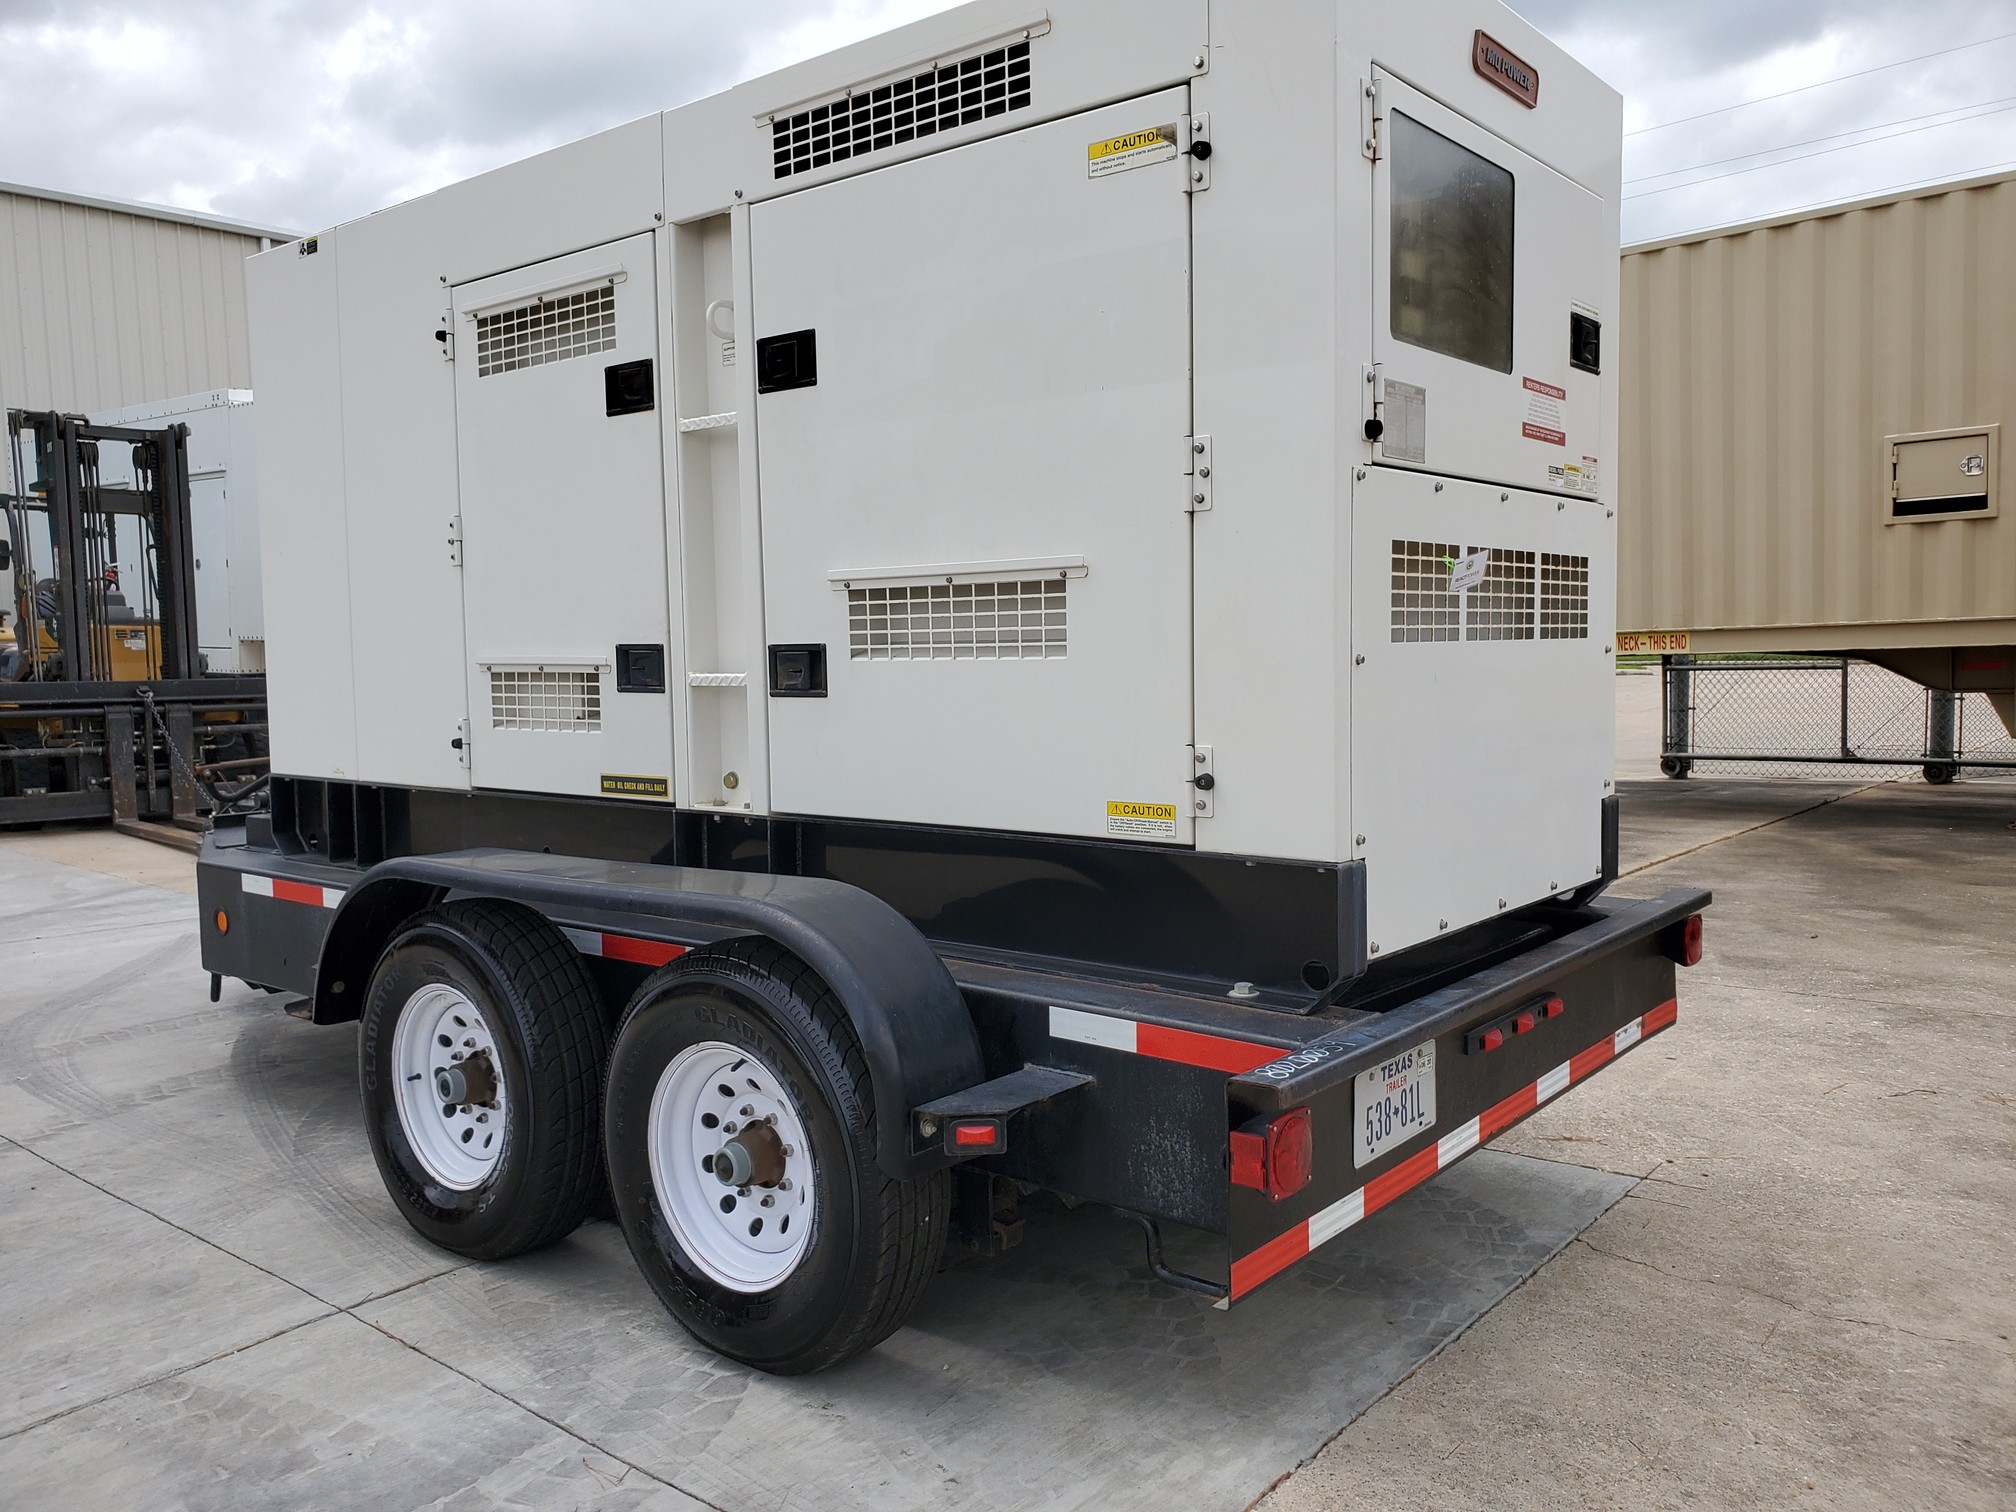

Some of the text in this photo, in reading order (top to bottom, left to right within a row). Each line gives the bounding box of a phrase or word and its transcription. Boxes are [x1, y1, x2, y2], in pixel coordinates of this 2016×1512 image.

[1486, 47, 1530, 91] MQ POWER
[1670, 634, 1686, 650] END
[645, 783, 653, 791] FILL
[1123, 805, 1171, 817] CAUTION
[366, 968, 402, 1092] GLADIATOR
[695, 1006, 814, 1121] GLADIATOR
[1381, 1053, 1413, 1082] TEXAS
[1385, 1074, 1407, 1094] TRAILER
